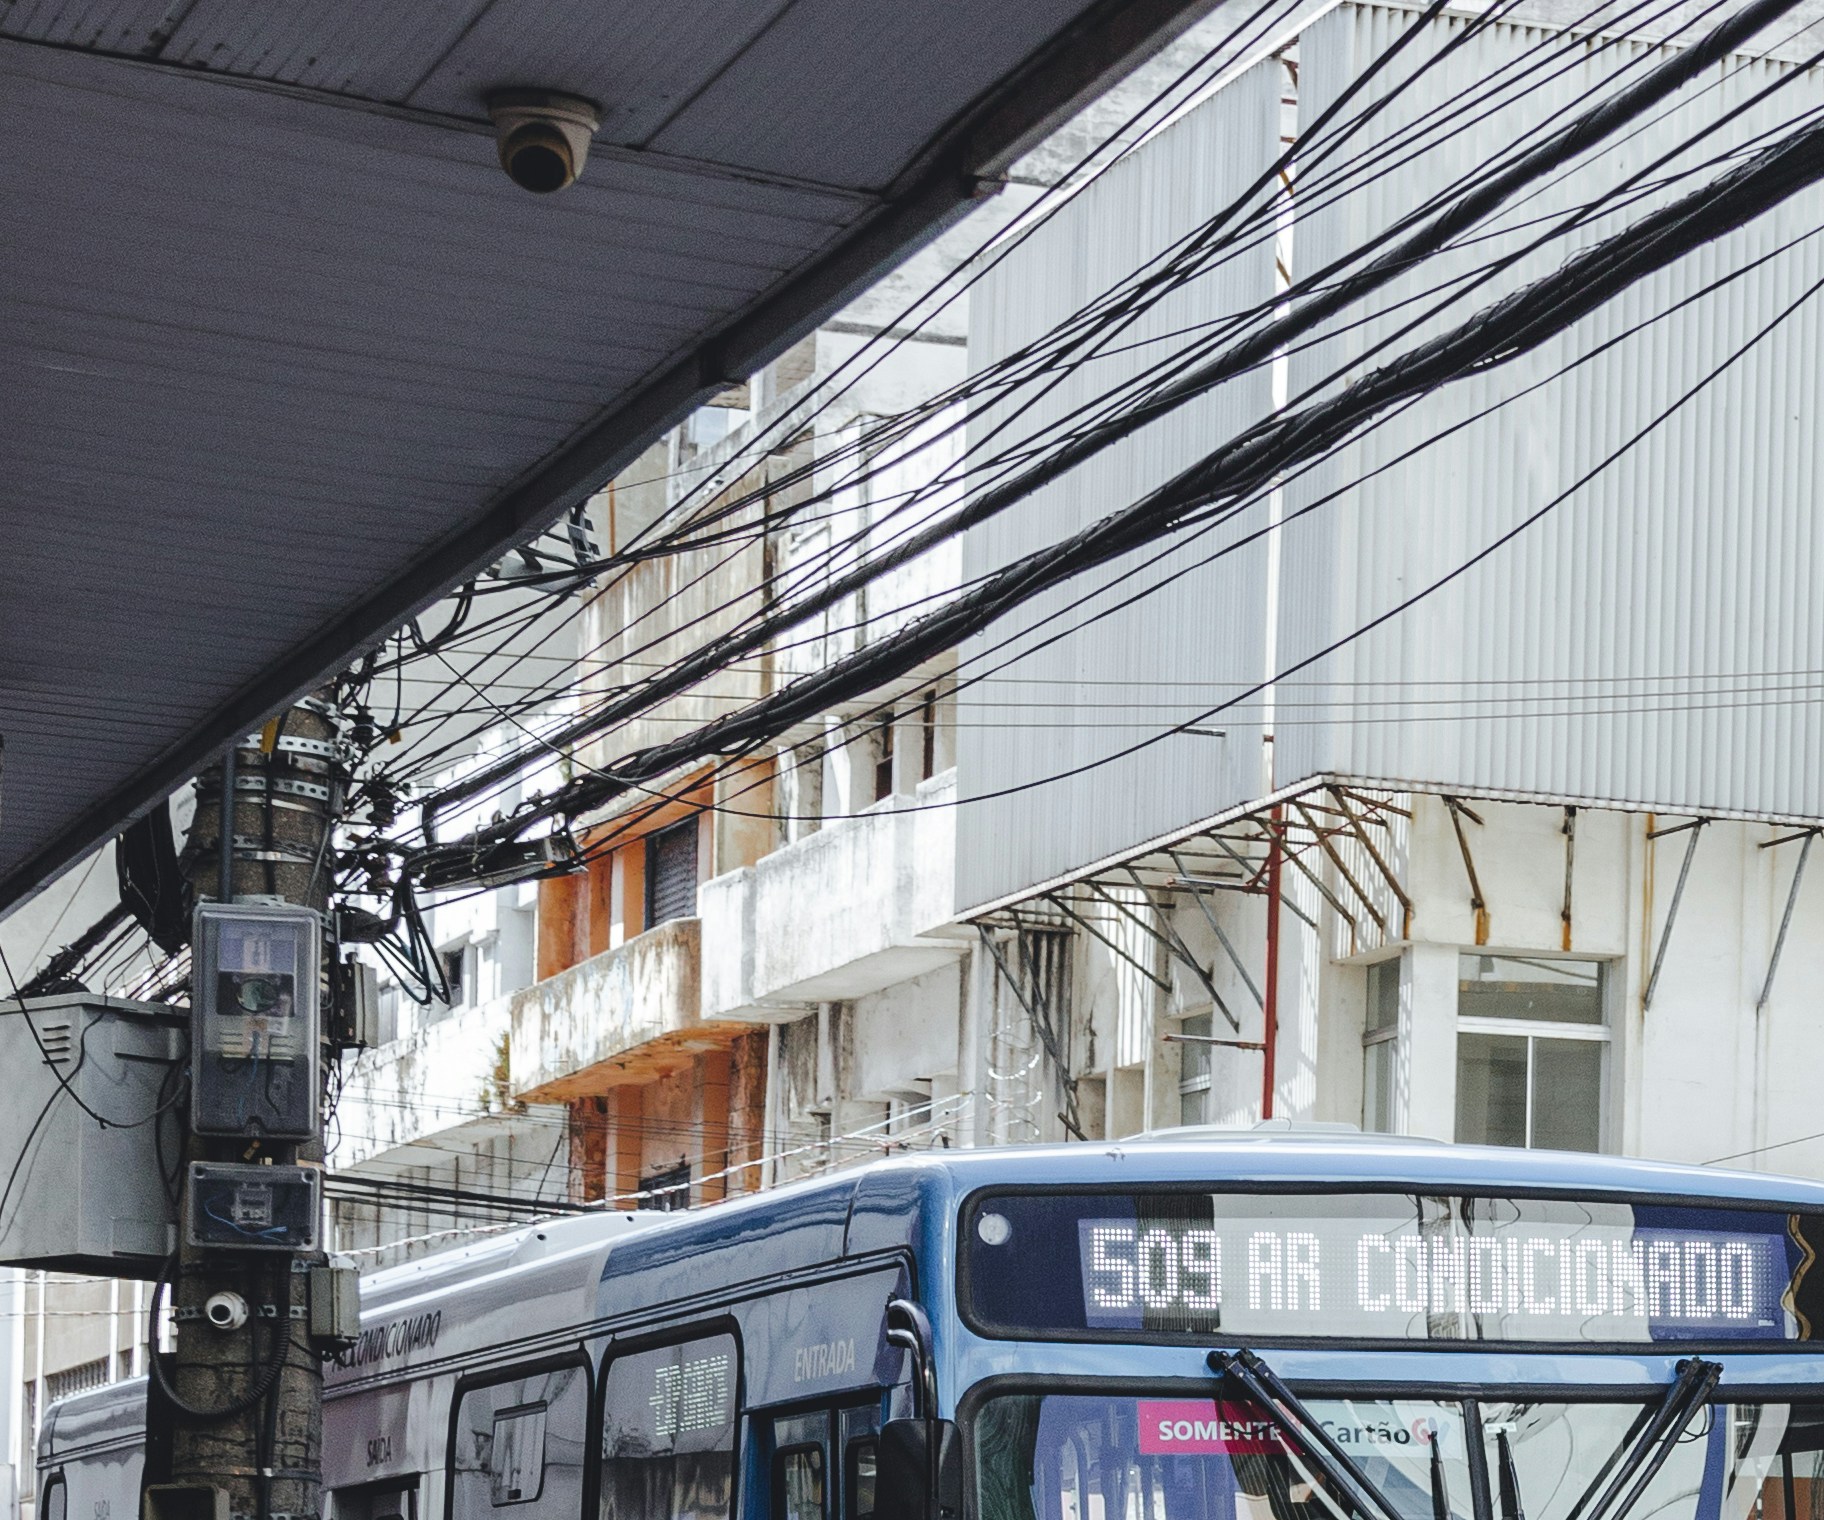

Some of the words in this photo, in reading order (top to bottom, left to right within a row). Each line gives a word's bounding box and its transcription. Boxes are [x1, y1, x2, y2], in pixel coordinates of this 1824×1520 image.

[1093, 1228, 1222, 1309] 509
[1249, 1231, 1321, 1311] AR
[1357, 1233, 1753, 1319] CONDICIONADO
[795, 1338, 856, 1382] ENTRADA
[1158, 1420, 1281, 1442] SOMENTE
